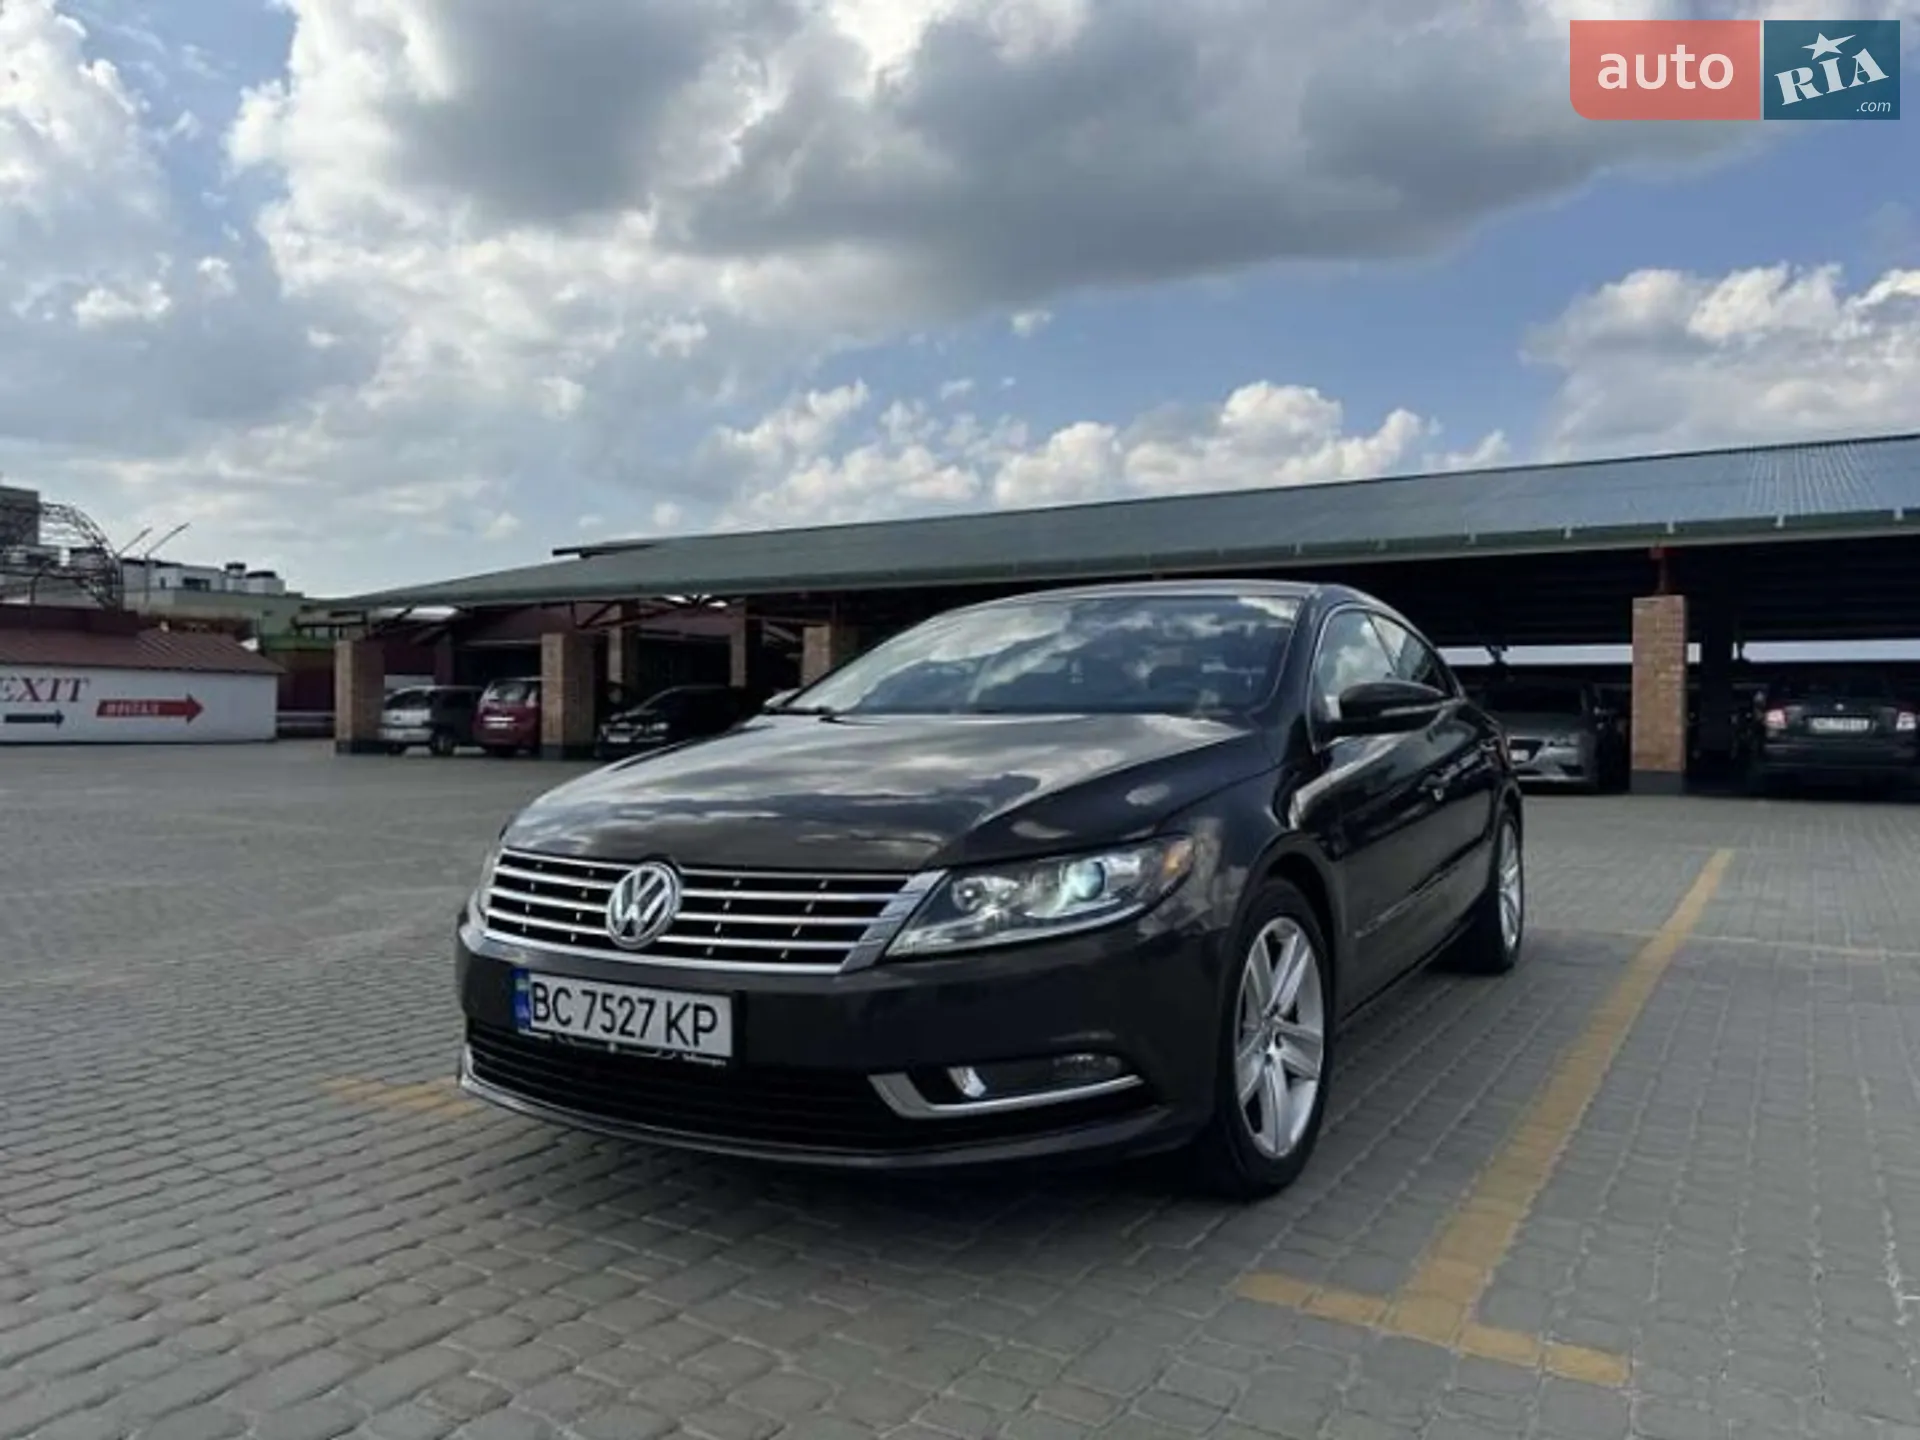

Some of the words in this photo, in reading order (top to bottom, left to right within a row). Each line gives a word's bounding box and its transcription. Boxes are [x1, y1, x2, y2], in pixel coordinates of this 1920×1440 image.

[531, 981, 573, 1027] BC
[580, 989, 657, 1039] 7527
[665, 1001, 718, 1048] KP
